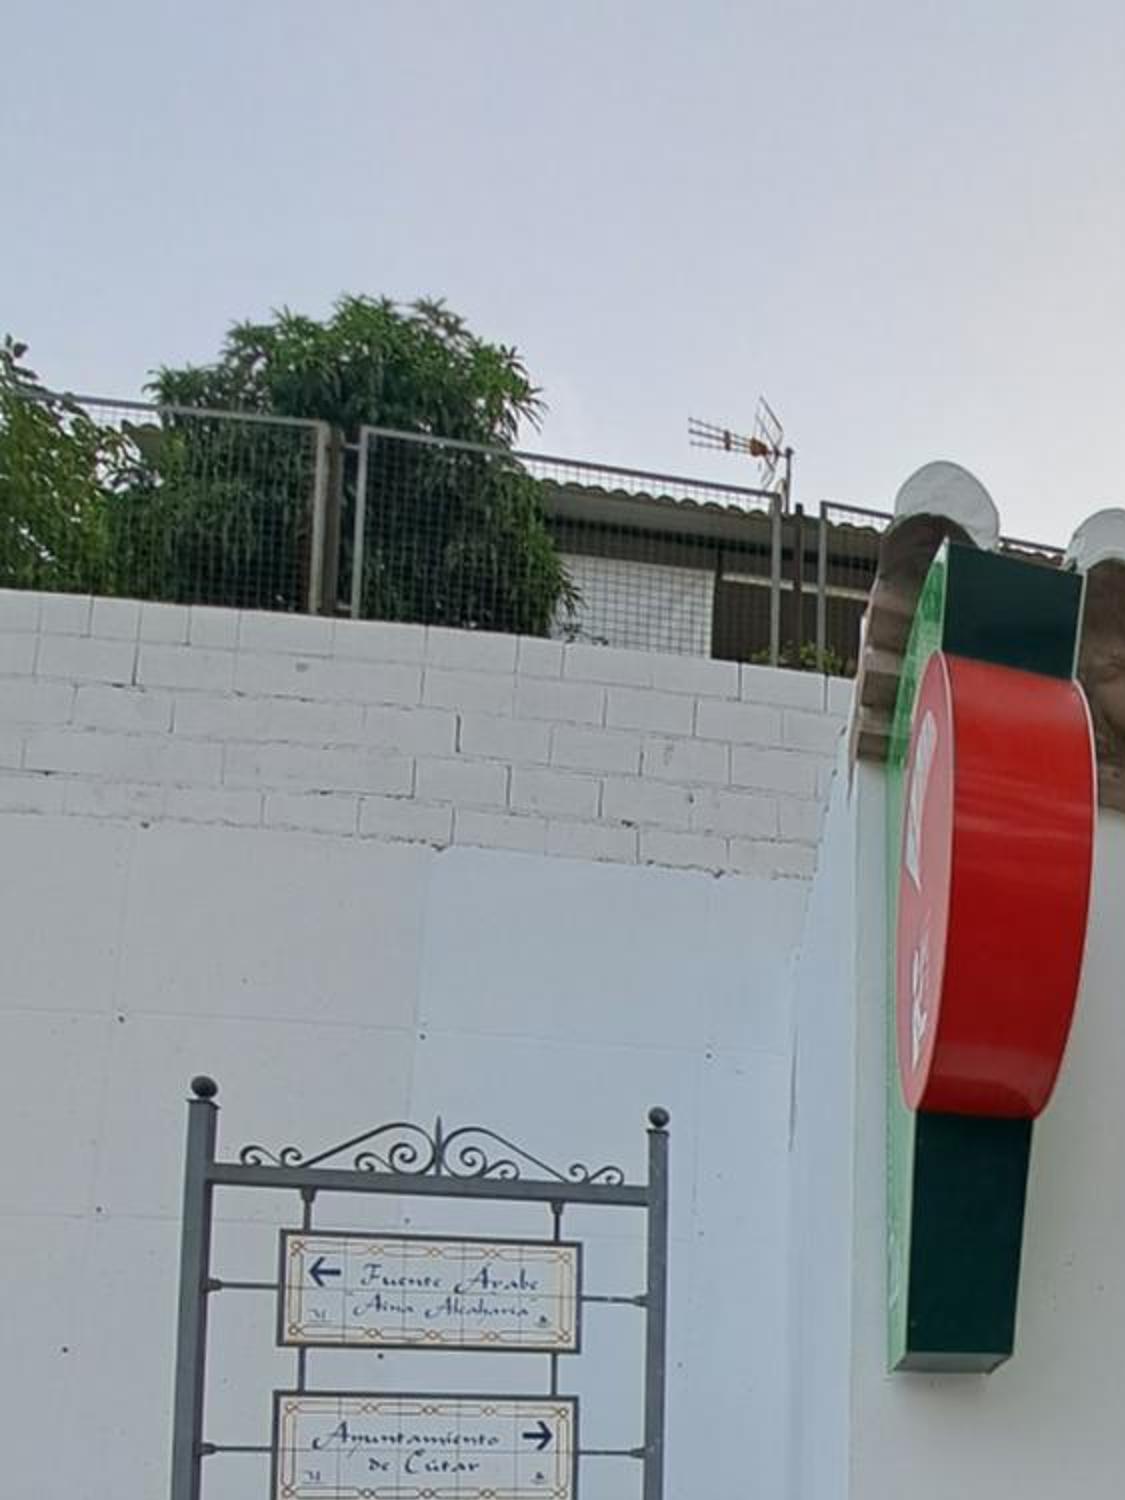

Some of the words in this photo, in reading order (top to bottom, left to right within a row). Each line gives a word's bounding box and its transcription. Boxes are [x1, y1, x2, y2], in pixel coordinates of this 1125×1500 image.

[360, 1262, 442, 1288] Fuente
[453, 1263, 539, 1294] Árabe
[311, 1420, 499, 1458] Ayuntamiento
[368, 1456, 391, 1473] de
[404, 1448, 480, 1475] Cútar
